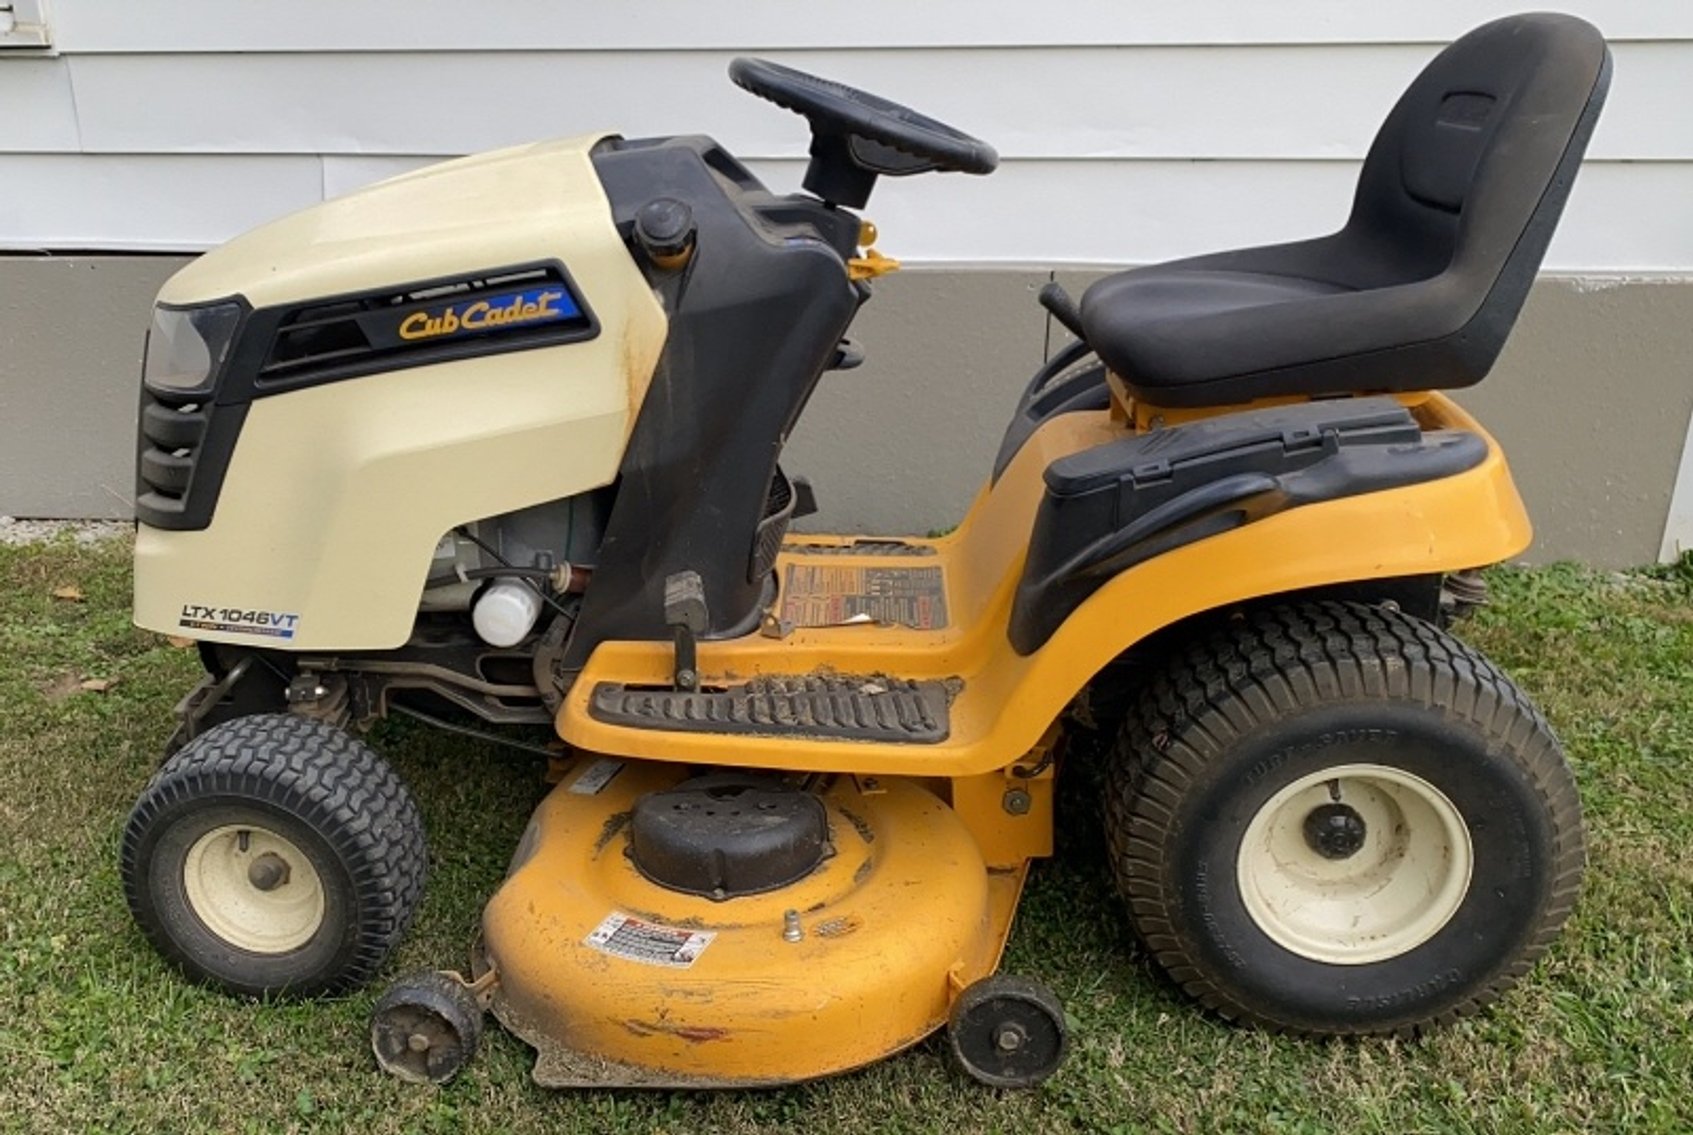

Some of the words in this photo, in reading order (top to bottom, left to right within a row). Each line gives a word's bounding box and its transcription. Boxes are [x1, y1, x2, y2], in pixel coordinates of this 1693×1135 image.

[400, 308, 460, 340] Cub
[460, 292, 562, 329] Cadet
[182, 604, 217, 620] LTX
[219, 608, 299, 628] 1046VT
